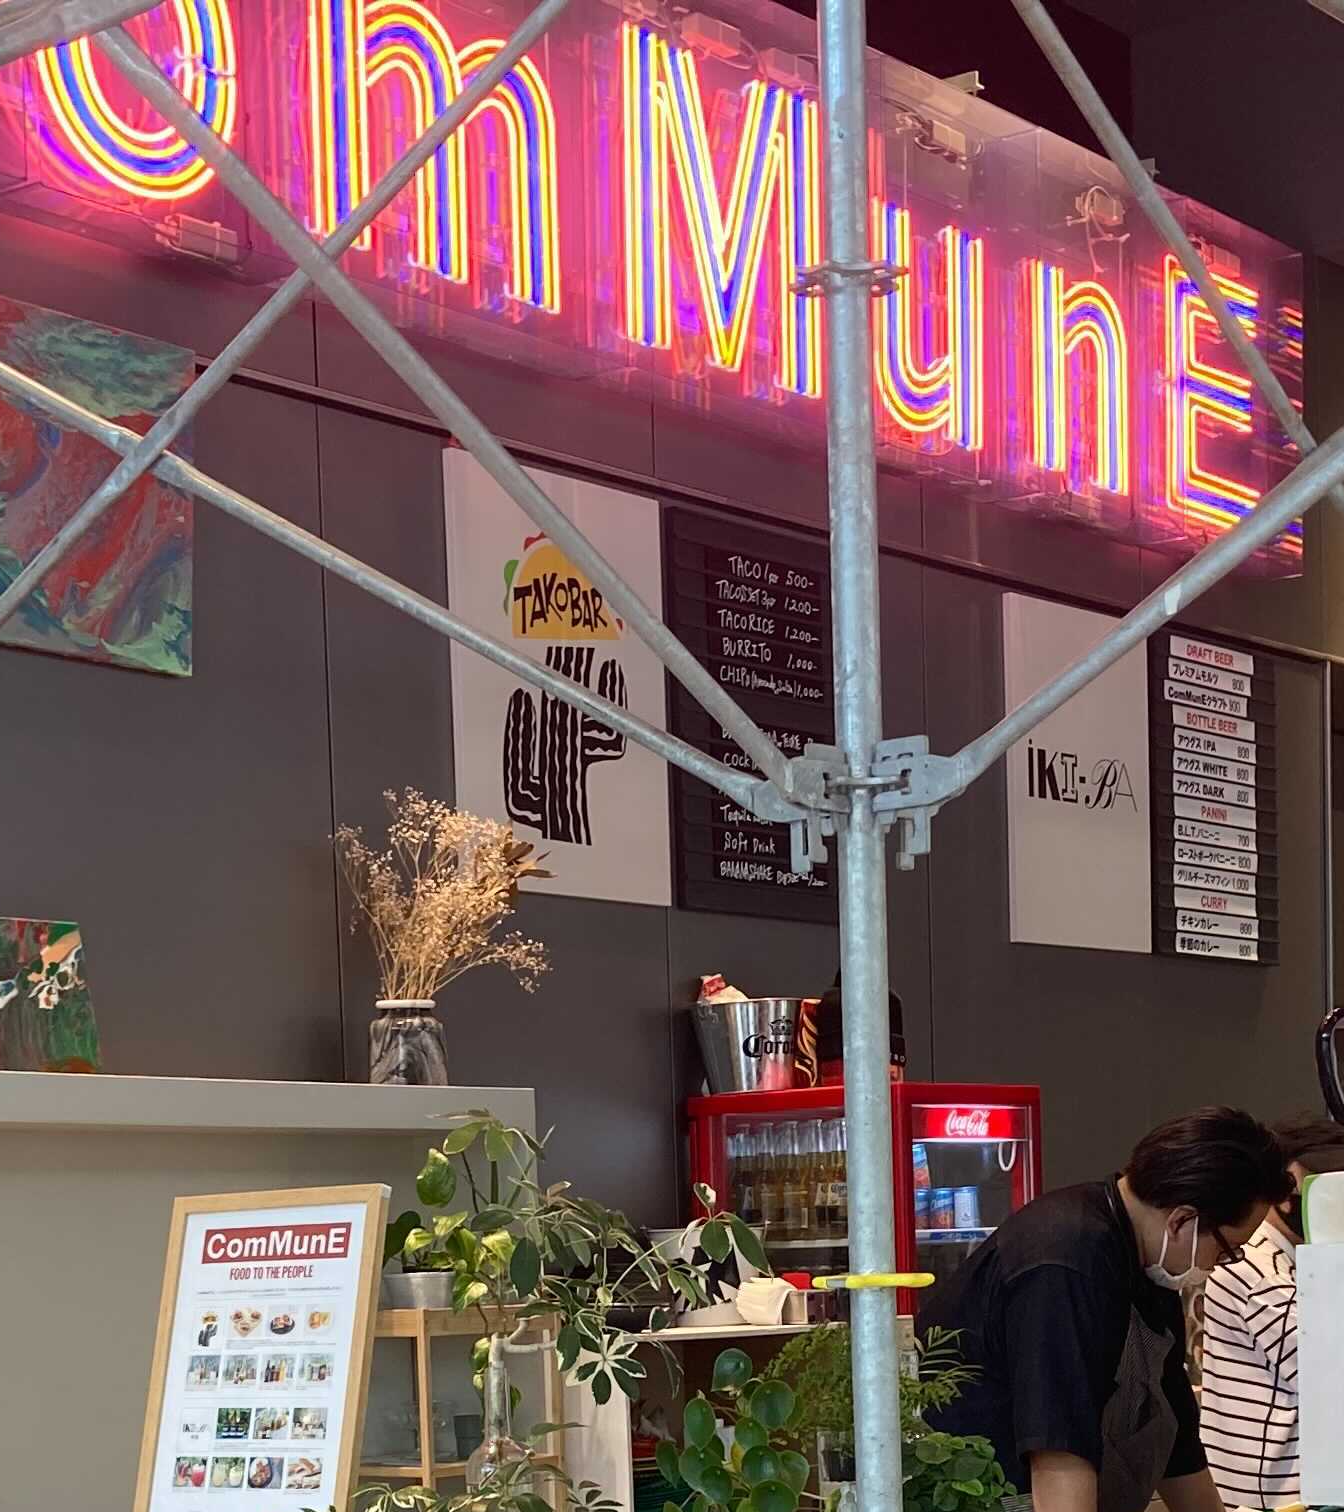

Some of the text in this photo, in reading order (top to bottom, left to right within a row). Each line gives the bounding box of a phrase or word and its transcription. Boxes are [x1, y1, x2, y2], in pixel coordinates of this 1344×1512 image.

[722, 637, 771, 663] BURRITO
[1186, 643, 1234, 667] DRAFT BEER
[1186, 712, 1238, 734] BOTTLE BEER
[1178, 734, 1201, 750] アウグス
[1203, 739, 1216, 753] IPA
[1177, 756, 1200, 772] アウグス
[1202, 762, 1229, 778] WHITE
[1176, 779, 1200, 794] アウグス
[1202, 784, 1225, 800] DARK
[1200, 805, 1228, 822] PANINI
[1200, 895, 1228, 911] CURRY
[1180, 915, 1220, 930] チキンカレー
[206, 1227, 347, 1260] ComMunE
[229, 1264, 314, 1281] FOOD TO THE PEOPLE
